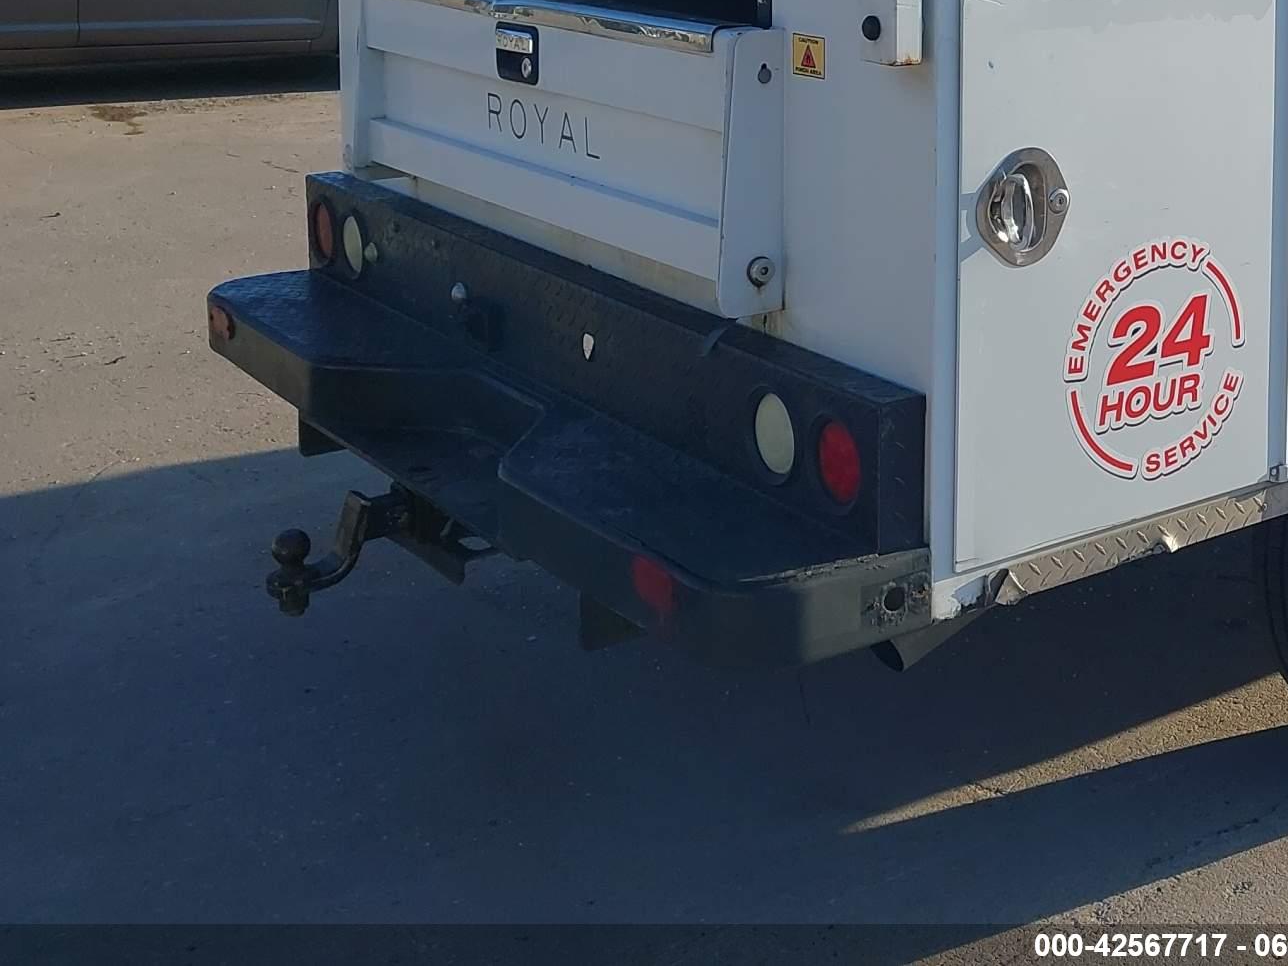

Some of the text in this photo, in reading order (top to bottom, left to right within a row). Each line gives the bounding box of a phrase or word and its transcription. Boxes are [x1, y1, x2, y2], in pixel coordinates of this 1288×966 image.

[487, 92, 601, 160] ROYAL
[1067, 240, 1206, 375] EMERGENCY
[1106, 294, 1211, 386] 24
[1099, 373, 1202, 427] HOUR
[1145, 372, 1240, 474] SERVICE
